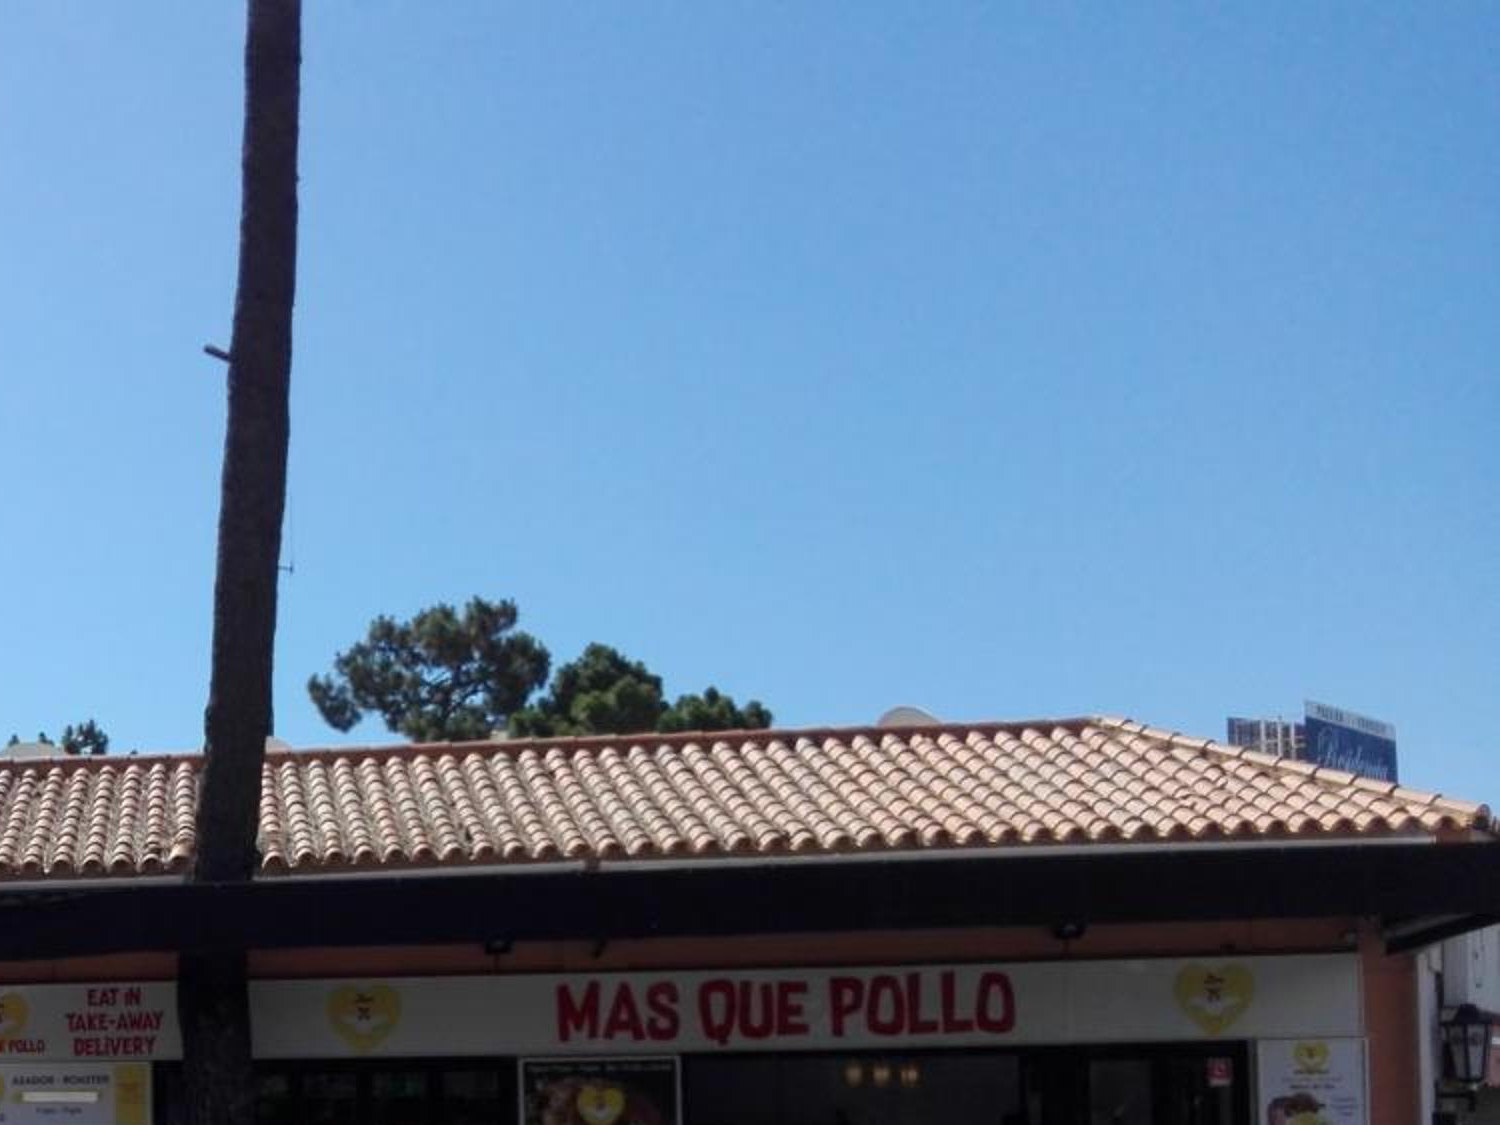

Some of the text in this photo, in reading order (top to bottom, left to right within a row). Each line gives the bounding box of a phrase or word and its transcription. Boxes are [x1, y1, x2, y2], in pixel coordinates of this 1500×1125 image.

[88, 989, 117, 1006] EAT
[556, 971, 1016, 1046] MAS QUE POLLO
[66, 1011, 163, 1032] TAKE-AWAY
